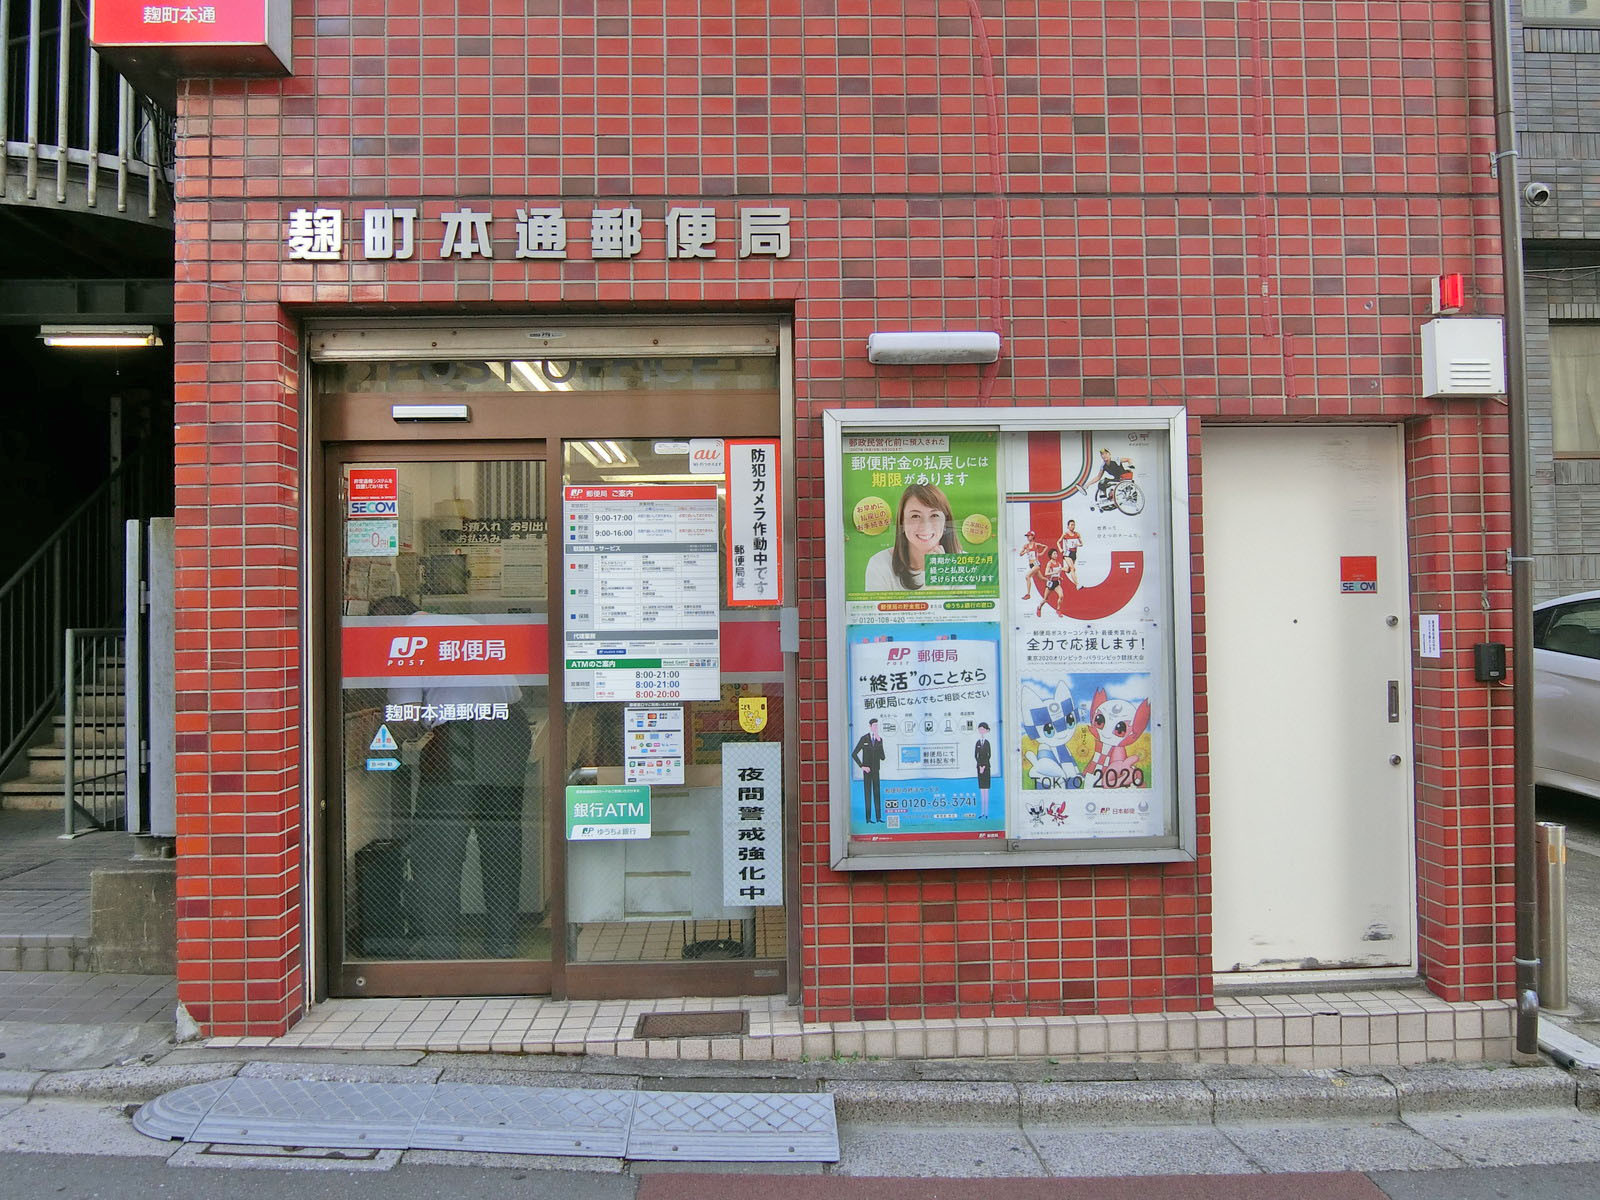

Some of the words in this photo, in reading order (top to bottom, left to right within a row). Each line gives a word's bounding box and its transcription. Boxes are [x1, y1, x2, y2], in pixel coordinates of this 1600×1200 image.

[143, 6, 216, 24] 麹町本通
[288, 207, 791, 260] 麹町本通郵便局
[848, 438, 945, 448] 郵政民営化前に預入された
[693, 448, 721, 461] au
[851, 455, 989, 471] 郵便貯金の払戻しには
[871, 472, 969, 487] 期限があります
[351, 502, 396, 513] SECOM
[751, 448, 769, 595] 防犯カメラ作動中です
[930, 566, 977, 574] 経つと払戻しが
[930, 575, 994, 583] 受けられなくなります
[859, 616, 906, 624] 0120-108-420
[439, 640, 506, 662] 郵便局
[917, 649, 958, 663] 郵便局
[571, 660, 616, 668] ATMのご案内
[635, 671, 680, 679] 8:00-21:00
[635, 680, 680, 688] 8:00-21:00
[635, 690, 680, 698] 8:00-20:00
[864, 689, 990, 710] 郵便局になんでもご相談ください
[385, 703, 509, 722] 麹町本通郵便局
[1030, 776, 1083, 789] TOKYO
[1092, 768, 1144, 789] 2020
[901, 797, 977, 808] 0120-65-3741
[573, 803, 644, 817] 銀行ATM
[597, 827, 637, 835] ゆうちょ銀行
[737, 767, 766, 900] 夜間警戒強化中
